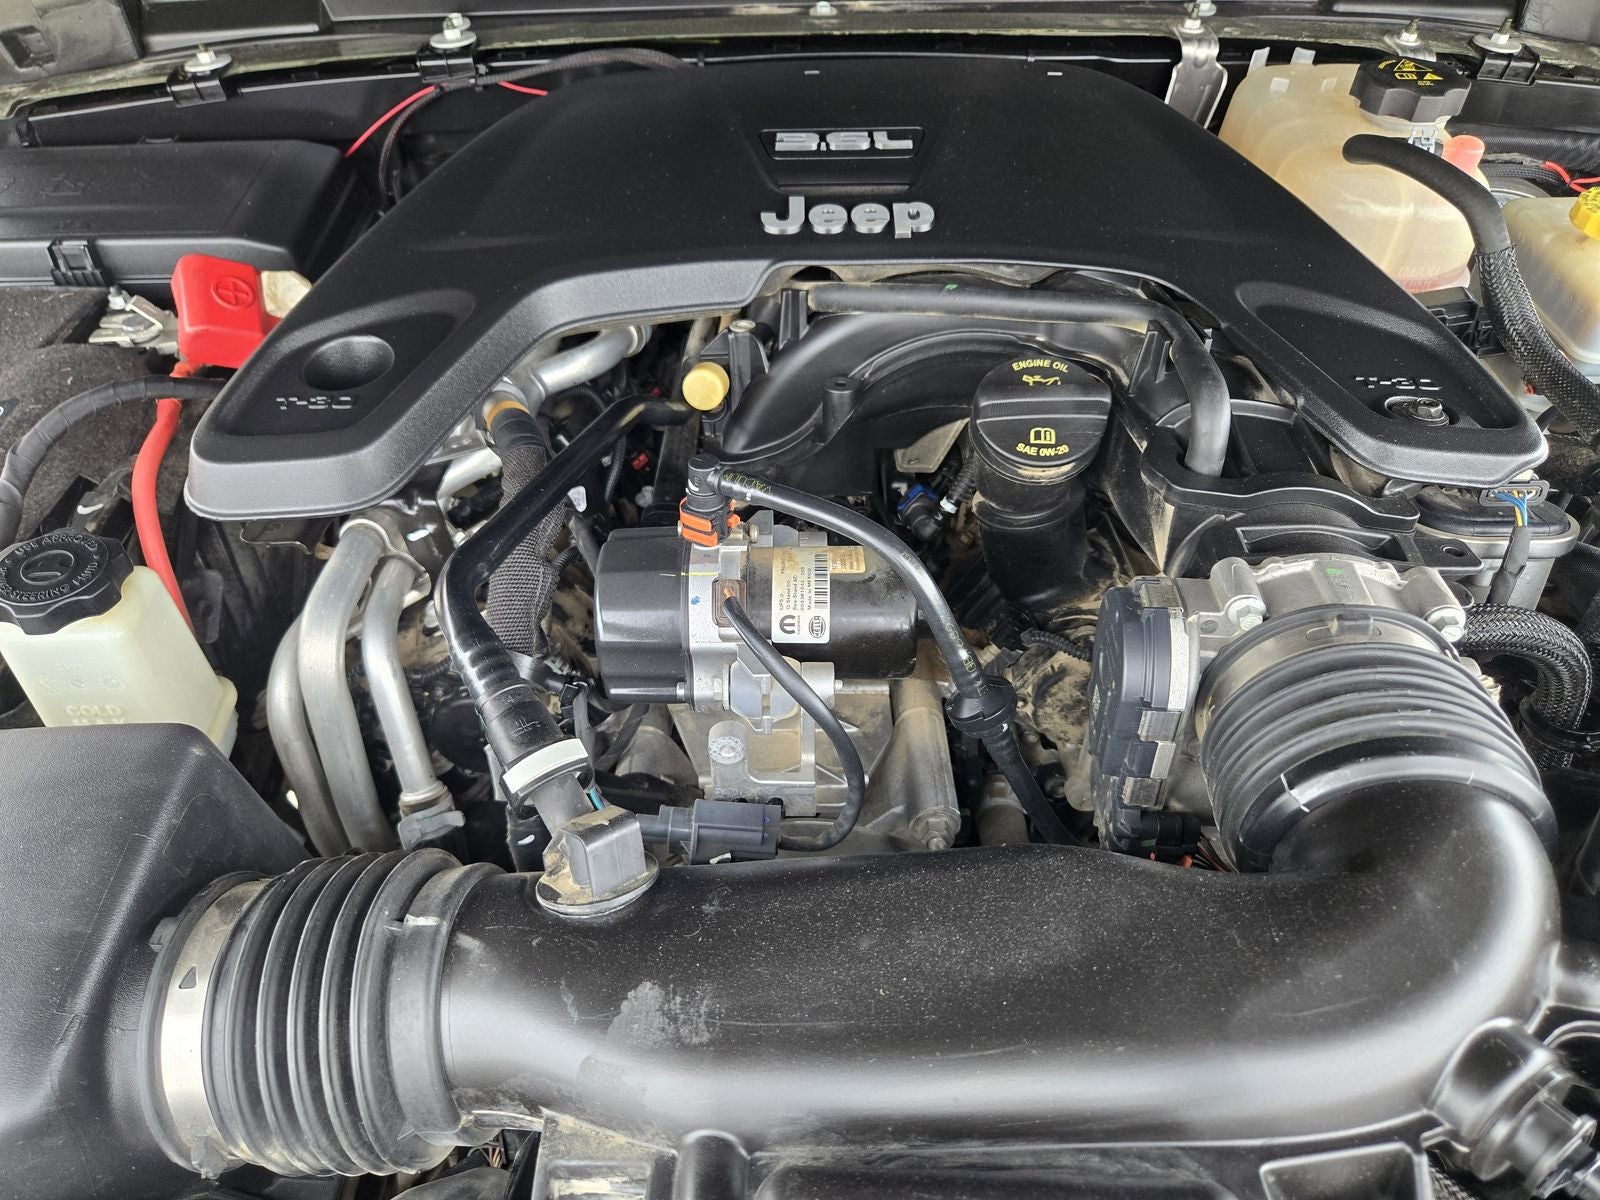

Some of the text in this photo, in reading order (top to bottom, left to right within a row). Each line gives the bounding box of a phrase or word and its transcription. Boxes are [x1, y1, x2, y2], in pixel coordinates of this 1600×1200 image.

[760, 195, 935, 239] Jeep
[1011, 359, 1070, 373] ENGINE OIL
[1015, 443, 1070, 457] SAE 0W-20
[14, 533, 99, 556] USE APPROVED
[9, 583, 71, 602] STEERING
[65, 704, 125, 718] COLD
